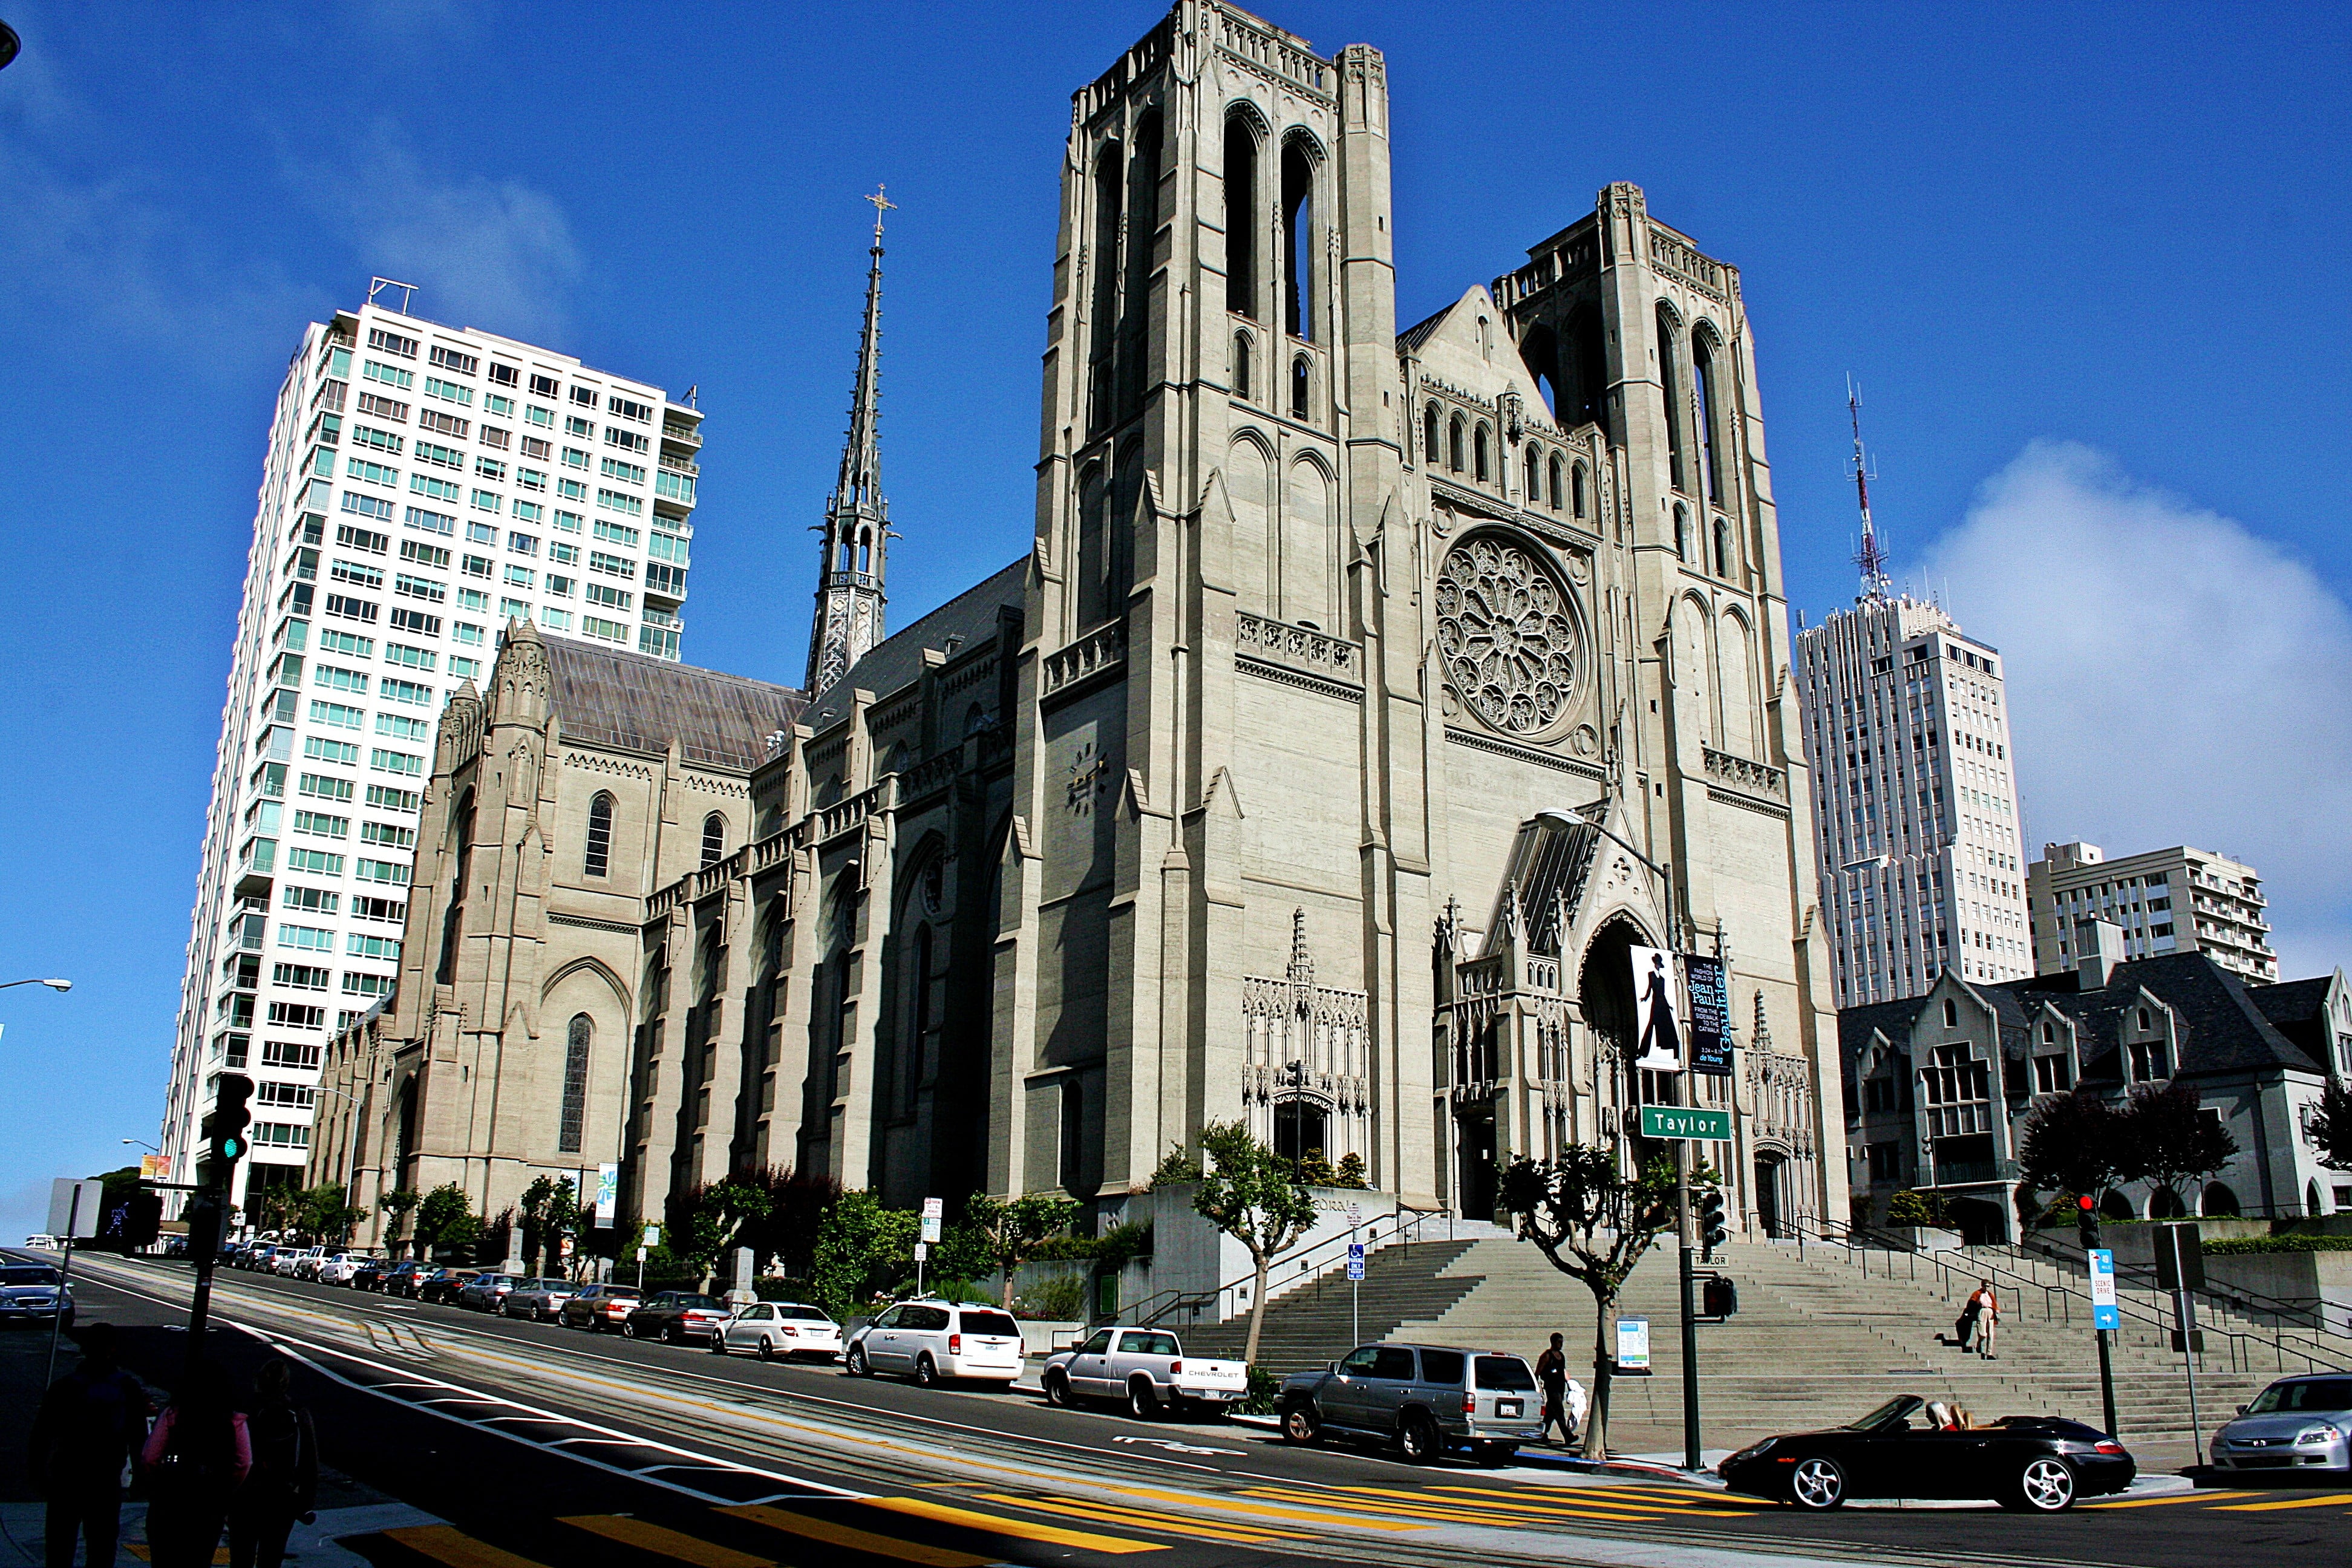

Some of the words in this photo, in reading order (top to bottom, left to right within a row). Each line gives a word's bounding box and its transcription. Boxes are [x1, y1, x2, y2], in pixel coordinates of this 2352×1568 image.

[1688, 980, 1714, 995] Jean
[1691, 991, 1716, 1005] Paul
[1714, 965, 1731, 1051] Gaultier
[1707, 1054, 1723, 1065] Young
[1655, 1113, 1717, 1134] Taylor
[1695, 1256, 1725, 1265] TALOR
